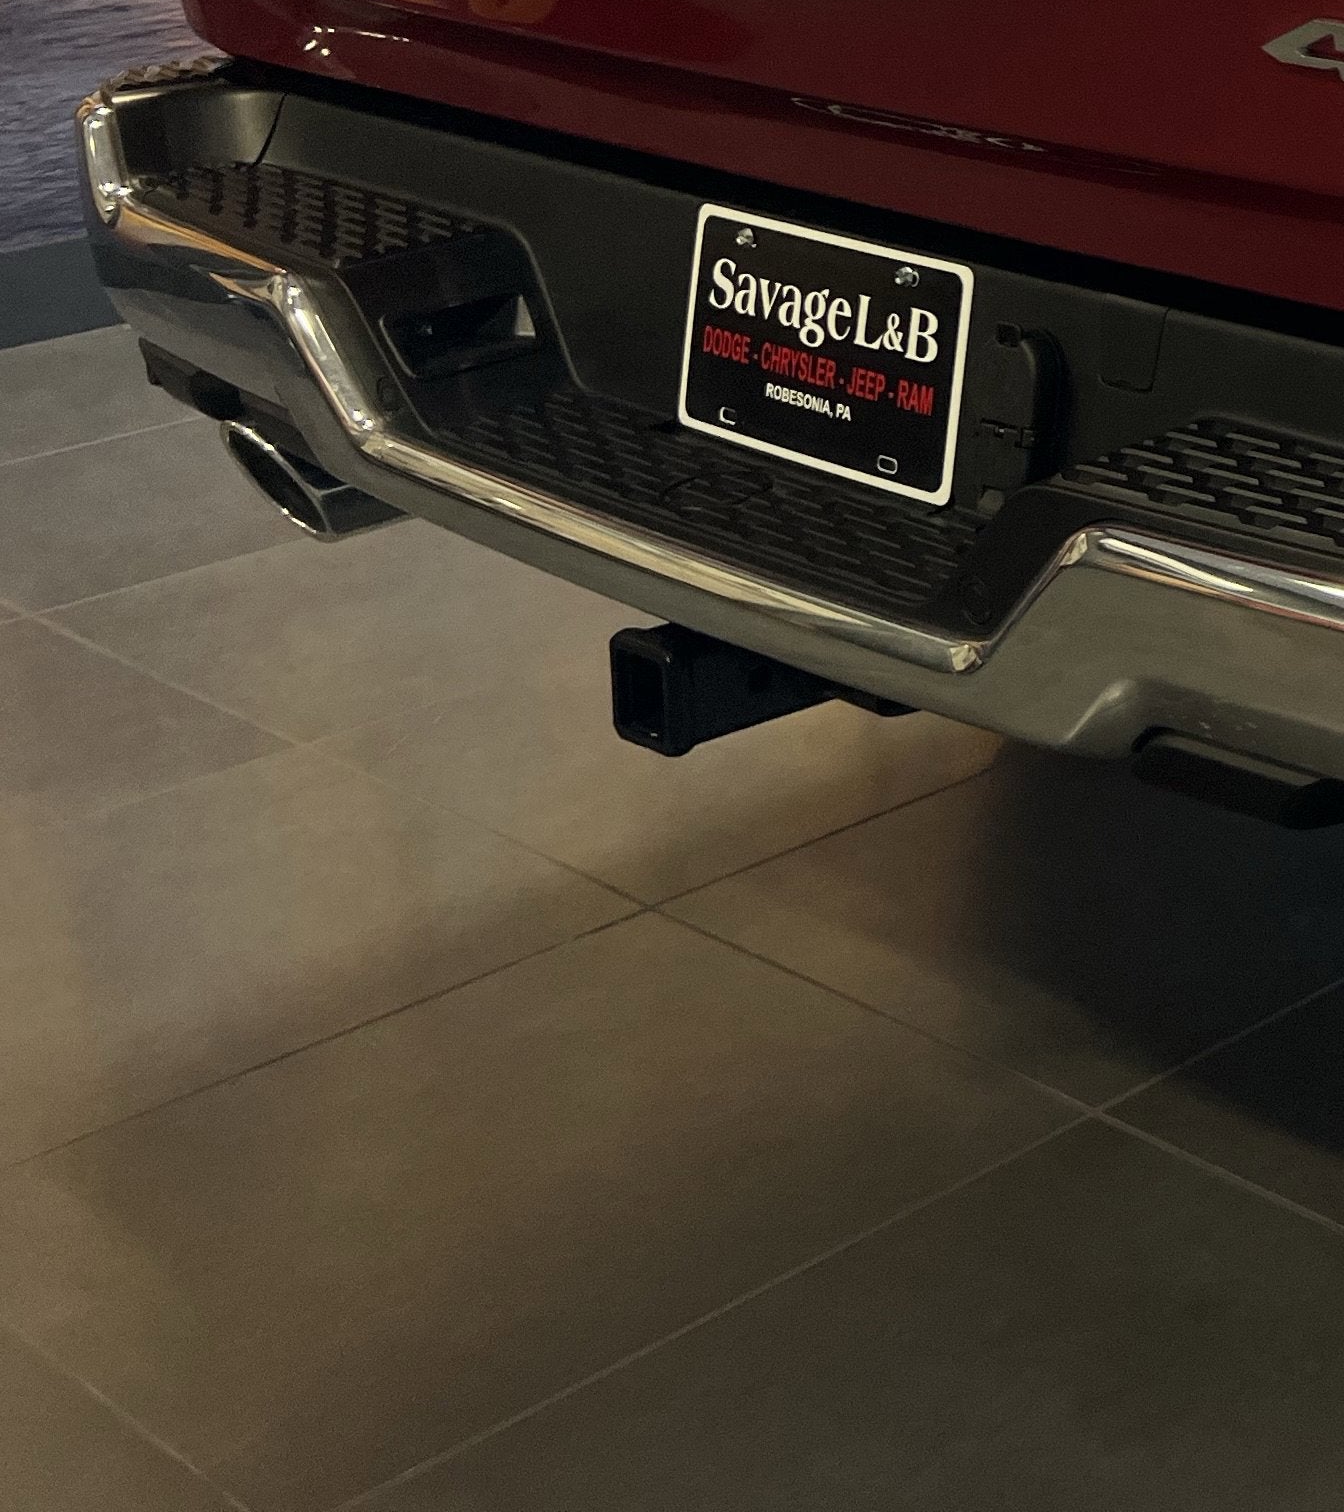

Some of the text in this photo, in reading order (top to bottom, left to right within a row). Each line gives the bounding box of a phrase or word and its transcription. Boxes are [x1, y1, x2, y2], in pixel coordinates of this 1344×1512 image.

[702, 325, 934, 417] DODGE CHRYSLER JEEP RAM
[765, 382, 852, 421] ROBESONIA, PA
